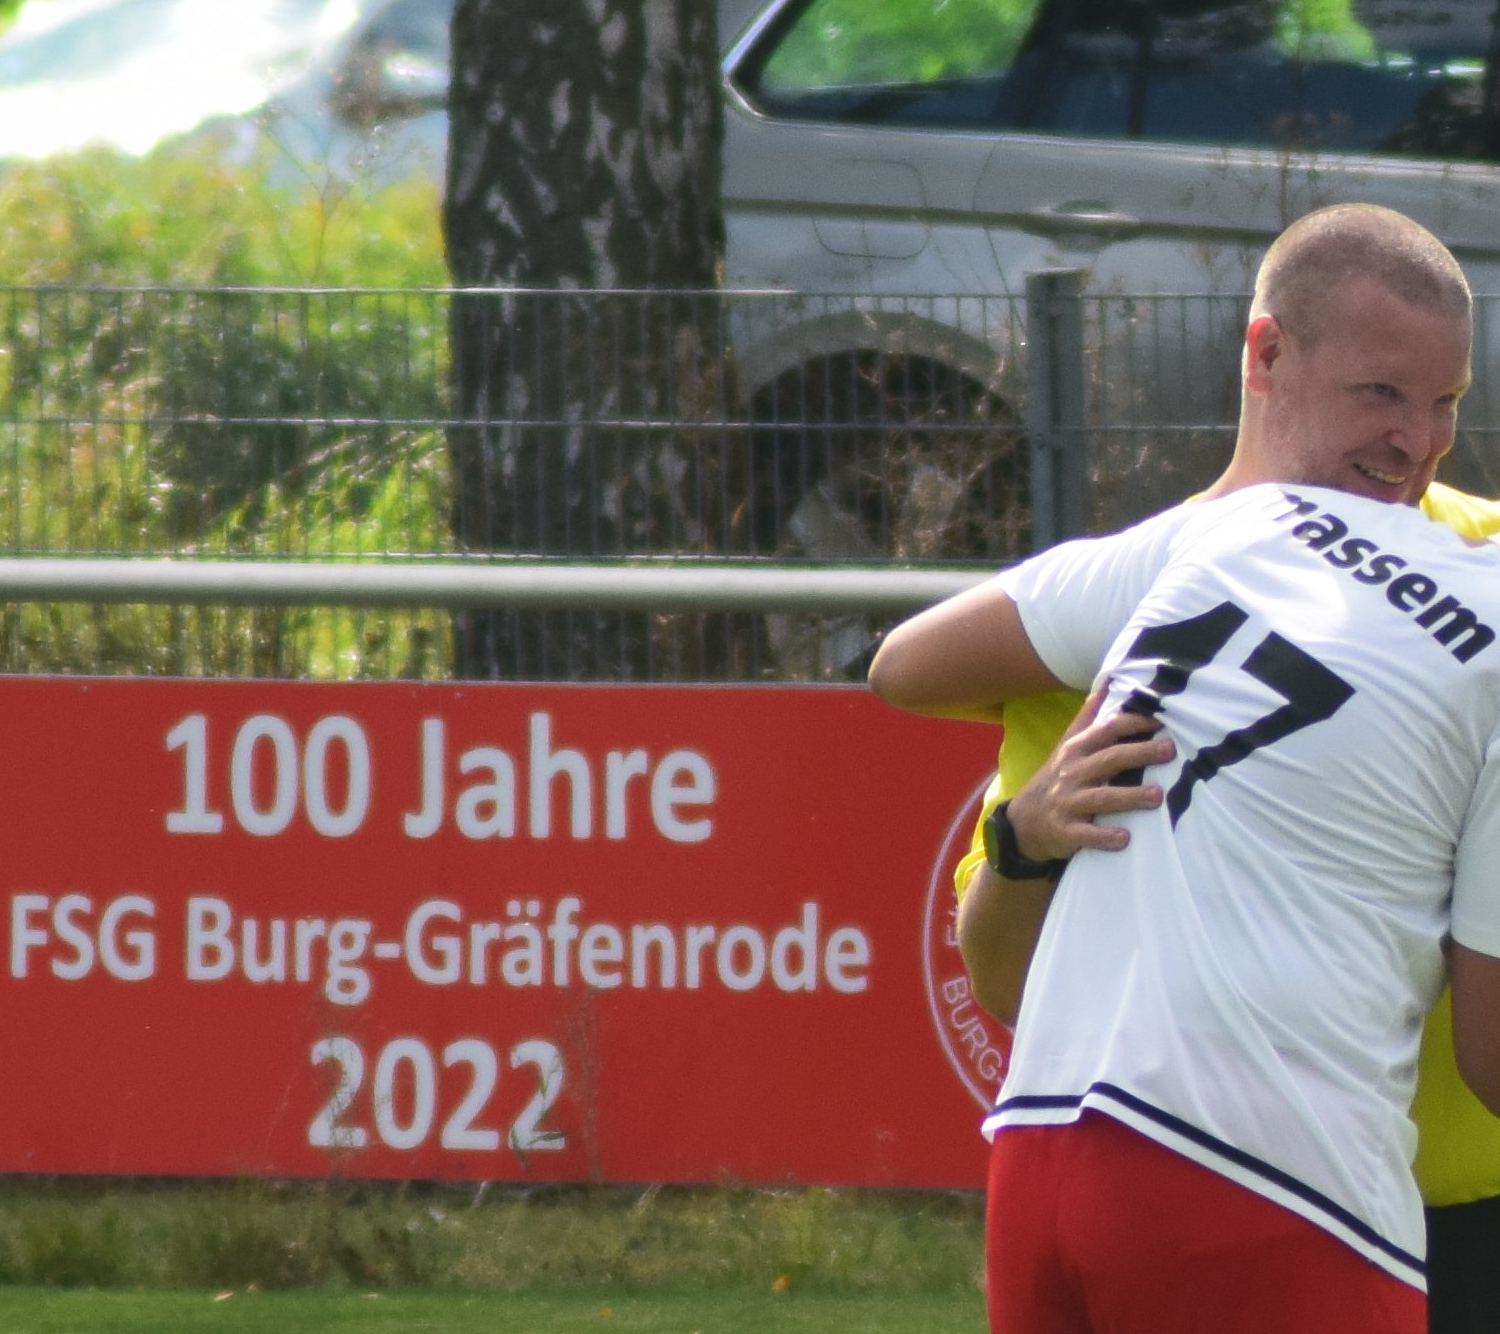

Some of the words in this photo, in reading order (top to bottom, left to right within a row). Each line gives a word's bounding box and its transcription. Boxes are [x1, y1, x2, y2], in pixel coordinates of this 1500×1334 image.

[162, 713, 372, 838] 100
[402, 712, 718, 844] Jahre
[1107, 599, 1357, 833] 17
[8, 894, 156, 982] FSG
[185, 894, 872, 1007] Burg-Gräfenrode
[307, 1036, 567, 1152] 2022
